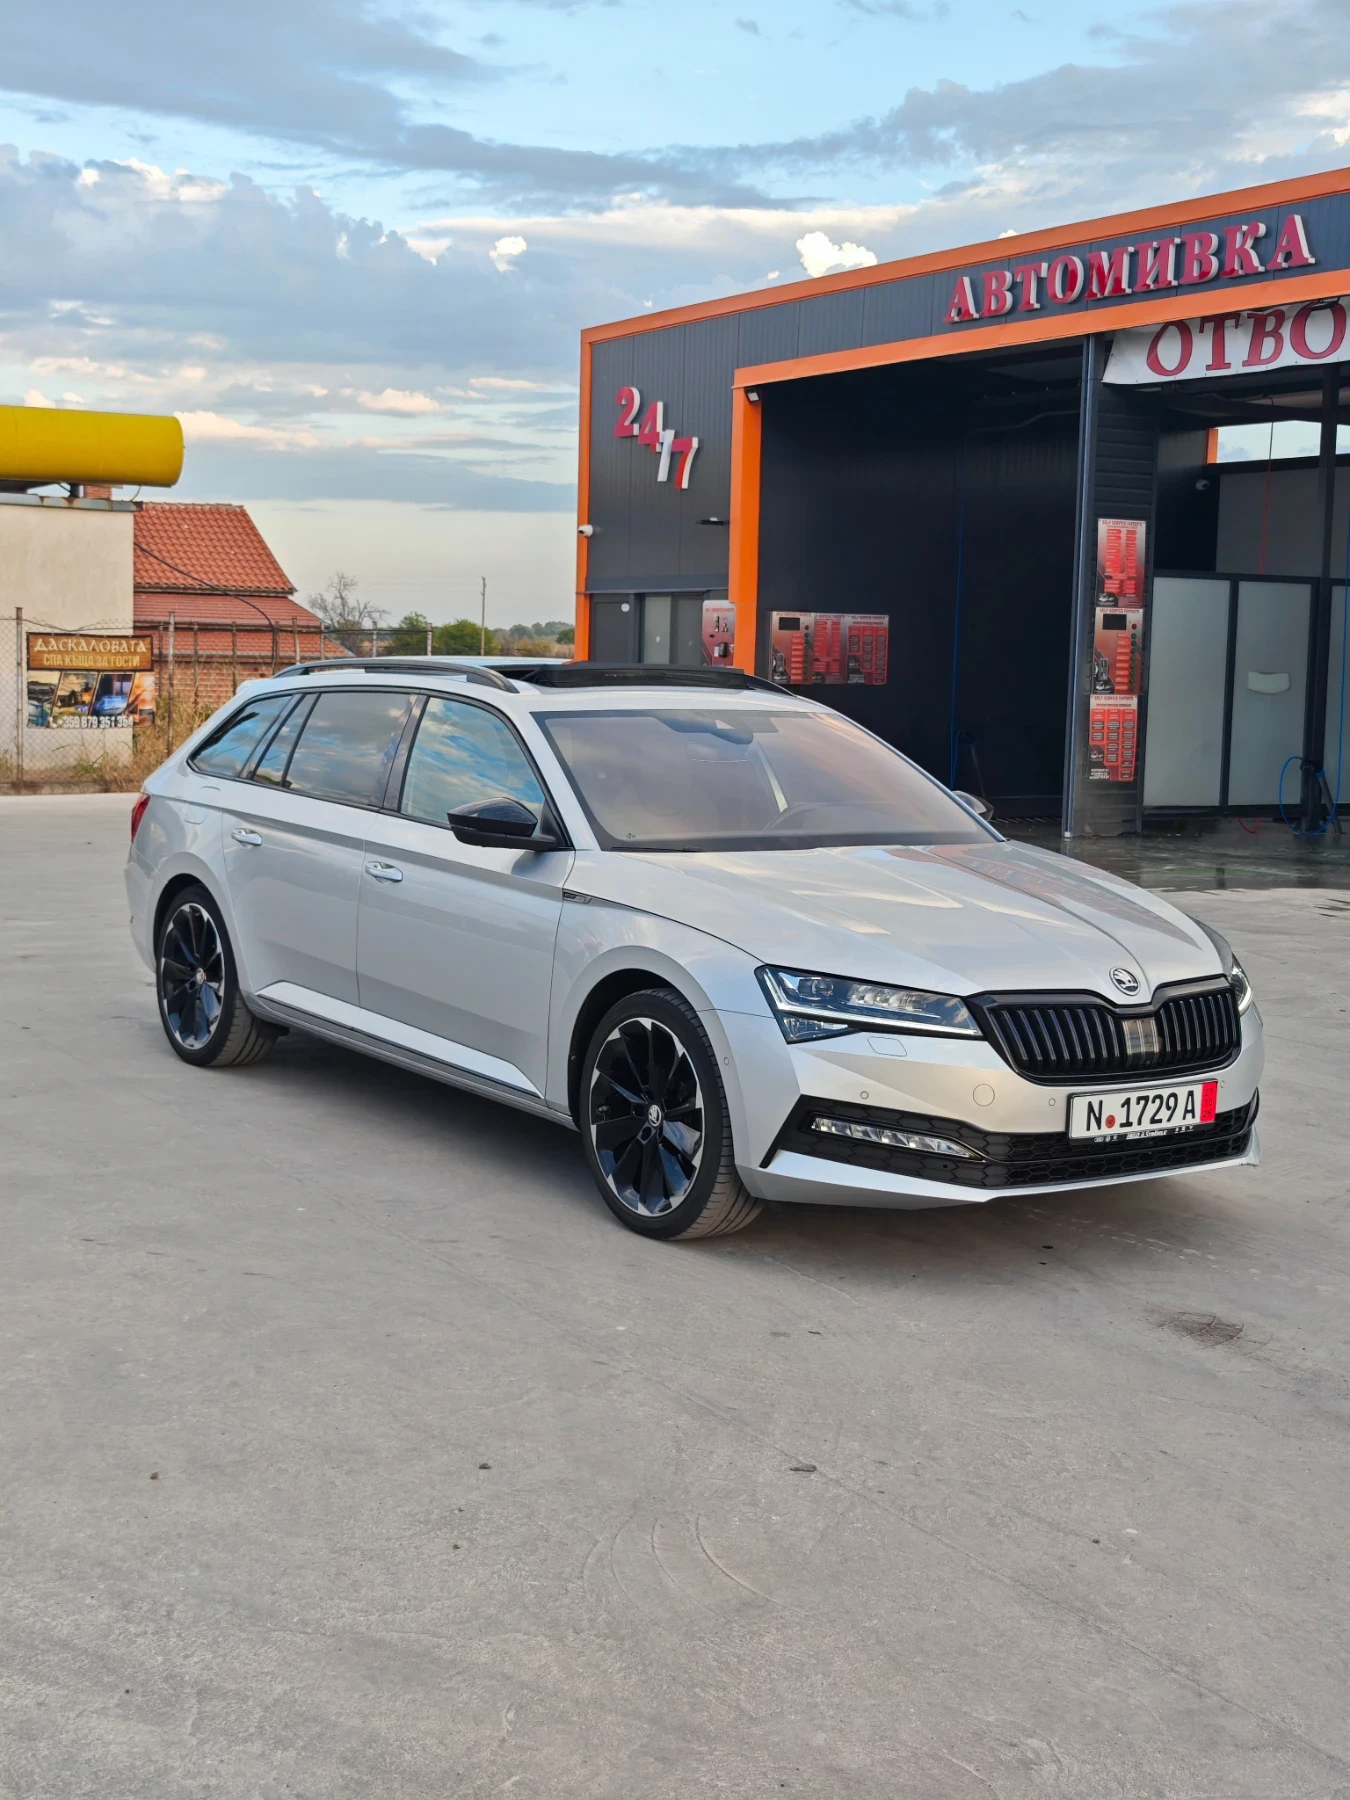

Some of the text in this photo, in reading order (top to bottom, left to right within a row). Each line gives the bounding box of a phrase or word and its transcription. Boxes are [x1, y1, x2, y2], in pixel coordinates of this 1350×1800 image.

[943, 214, 1316, 324] АВТОМИВКА
[613, 386, 699, 490] 24/7
[34, 637, 147, 653] ДАСКАЛОВАТА
[43, 654, 140, 667] СПА КЪЩА ЗА ГОСТИ
[57, 715, 80, 728] +359
[81, 715, 98, 728] 879
[99, 716, 115, 728] 351
[1086, 1090, 1196, 1132] N 1729 A
